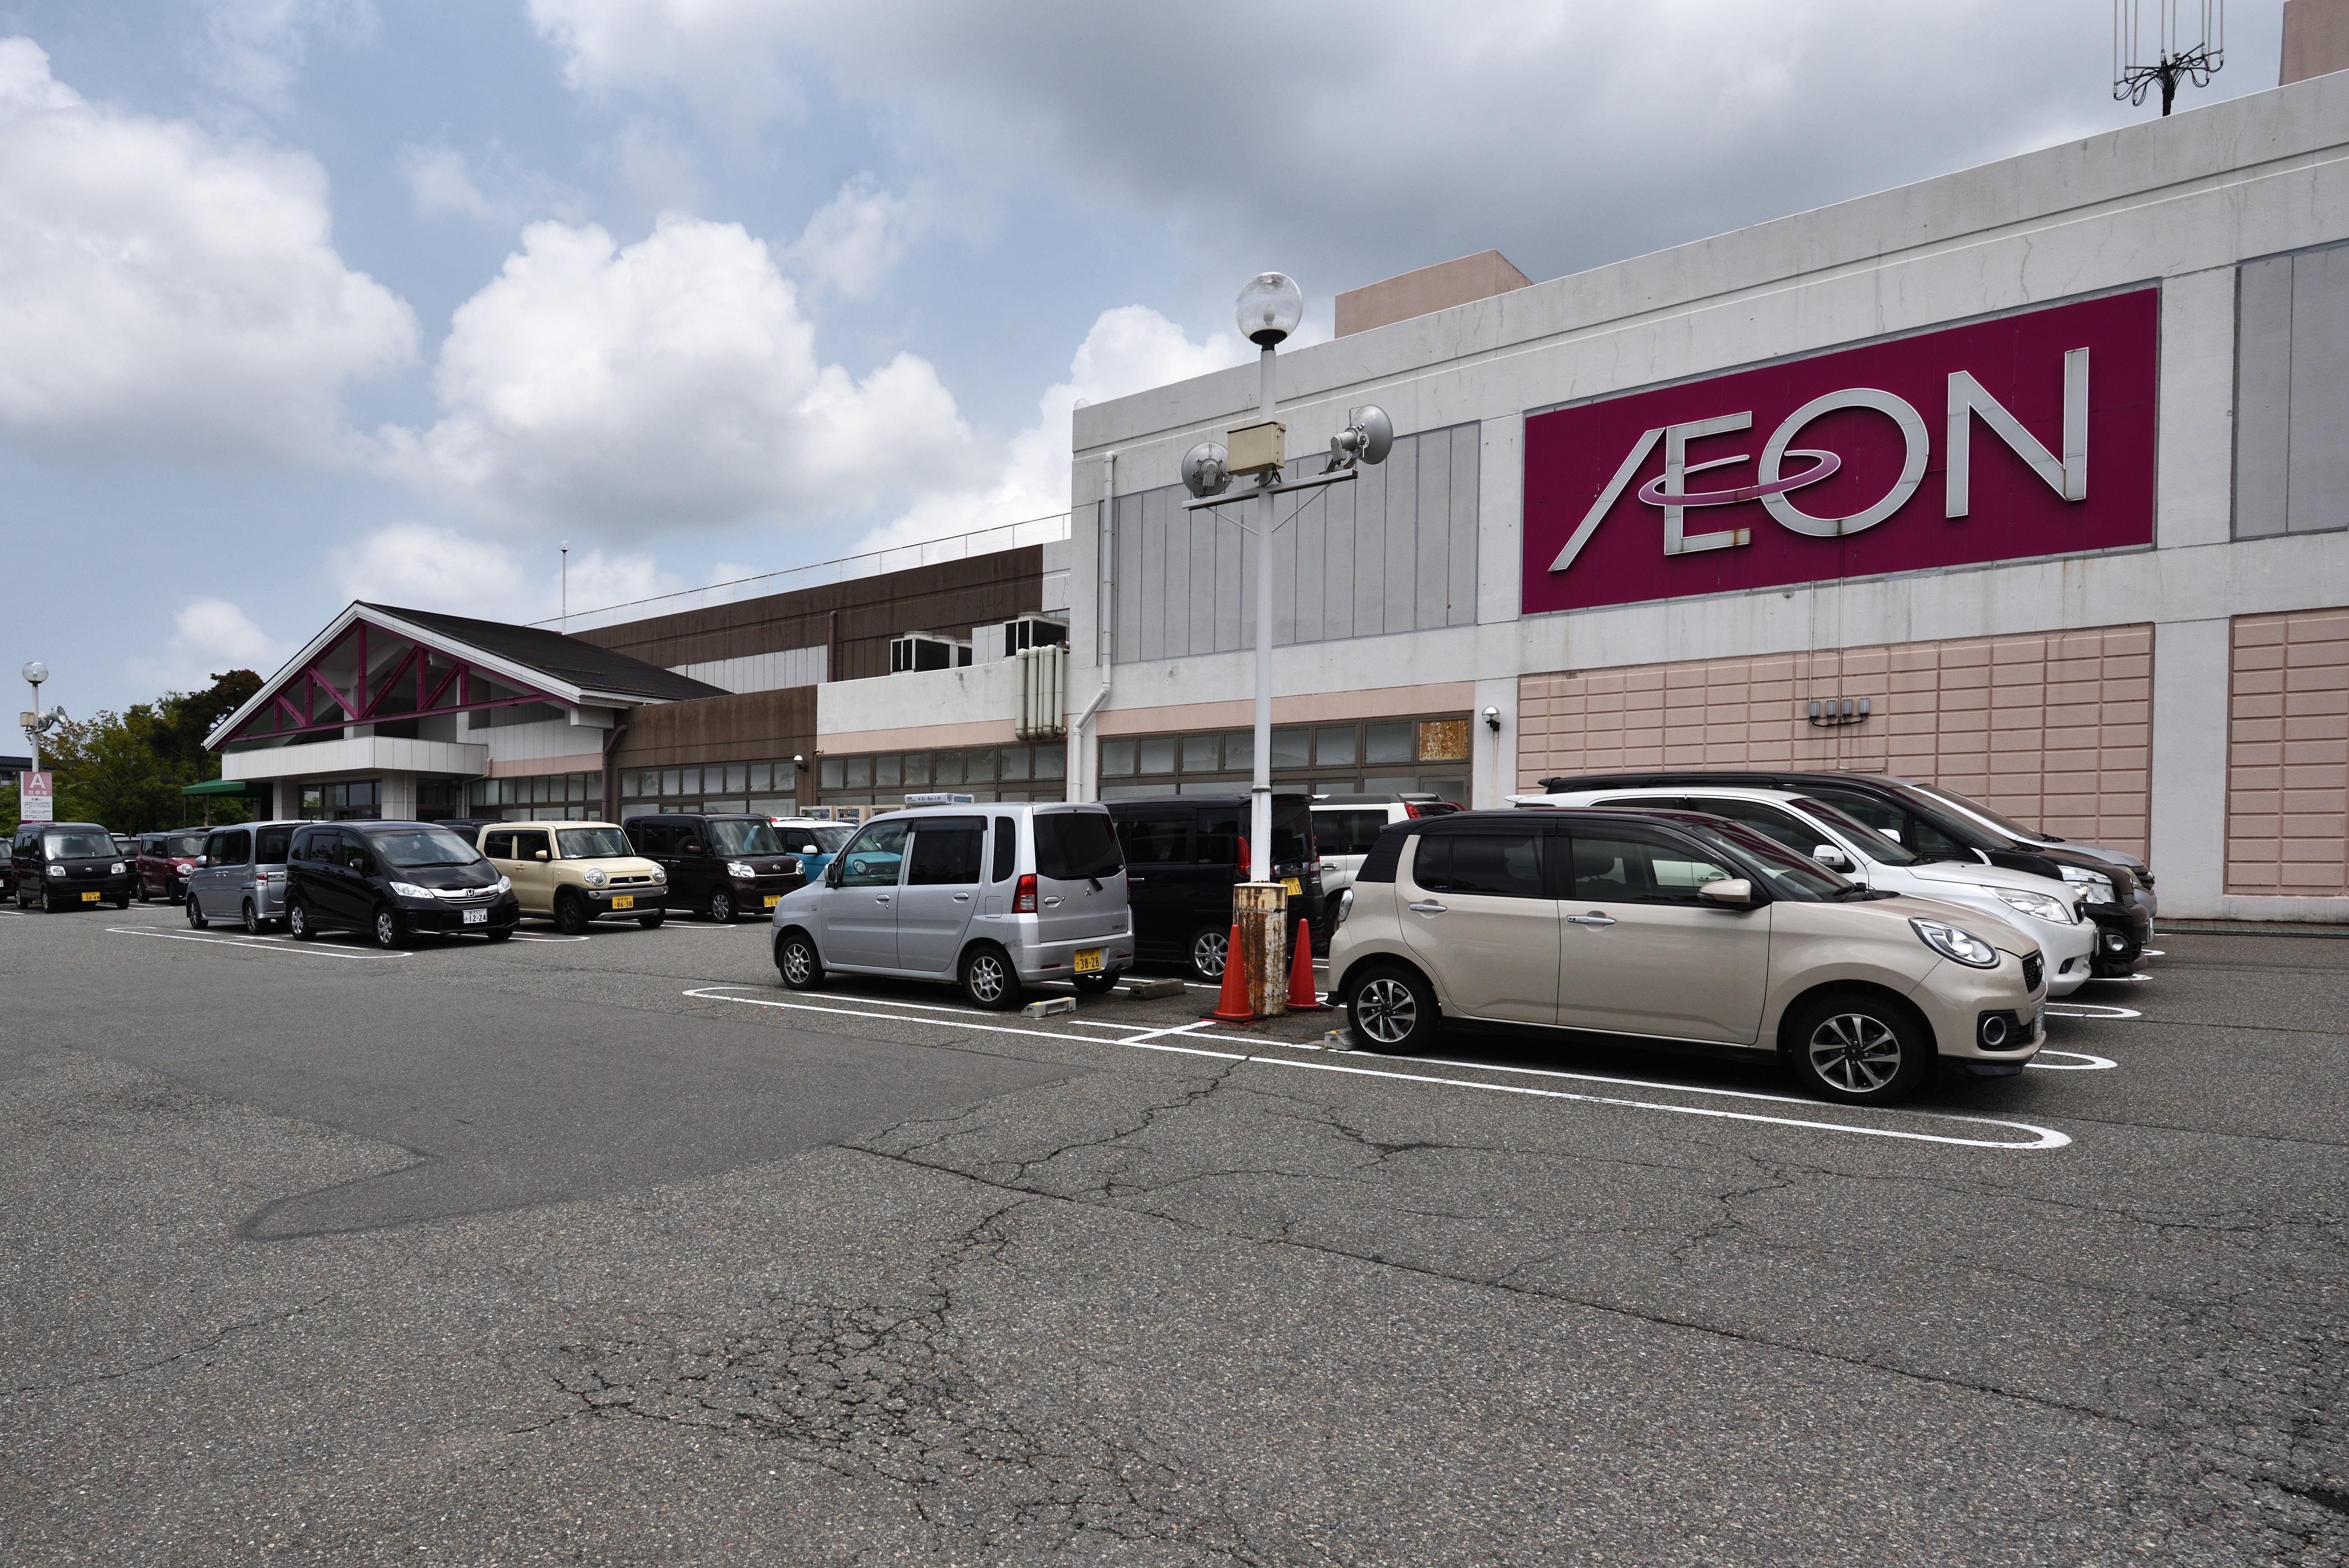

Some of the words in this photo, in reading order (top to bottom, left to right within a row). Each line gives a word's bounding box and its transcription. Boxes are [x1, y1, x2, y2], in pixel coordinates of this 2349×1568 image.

[29, 773, 46, 788] A
[470, 914, 486, 922] 12-24
[1080, 956, 1100, 969] 38-28
